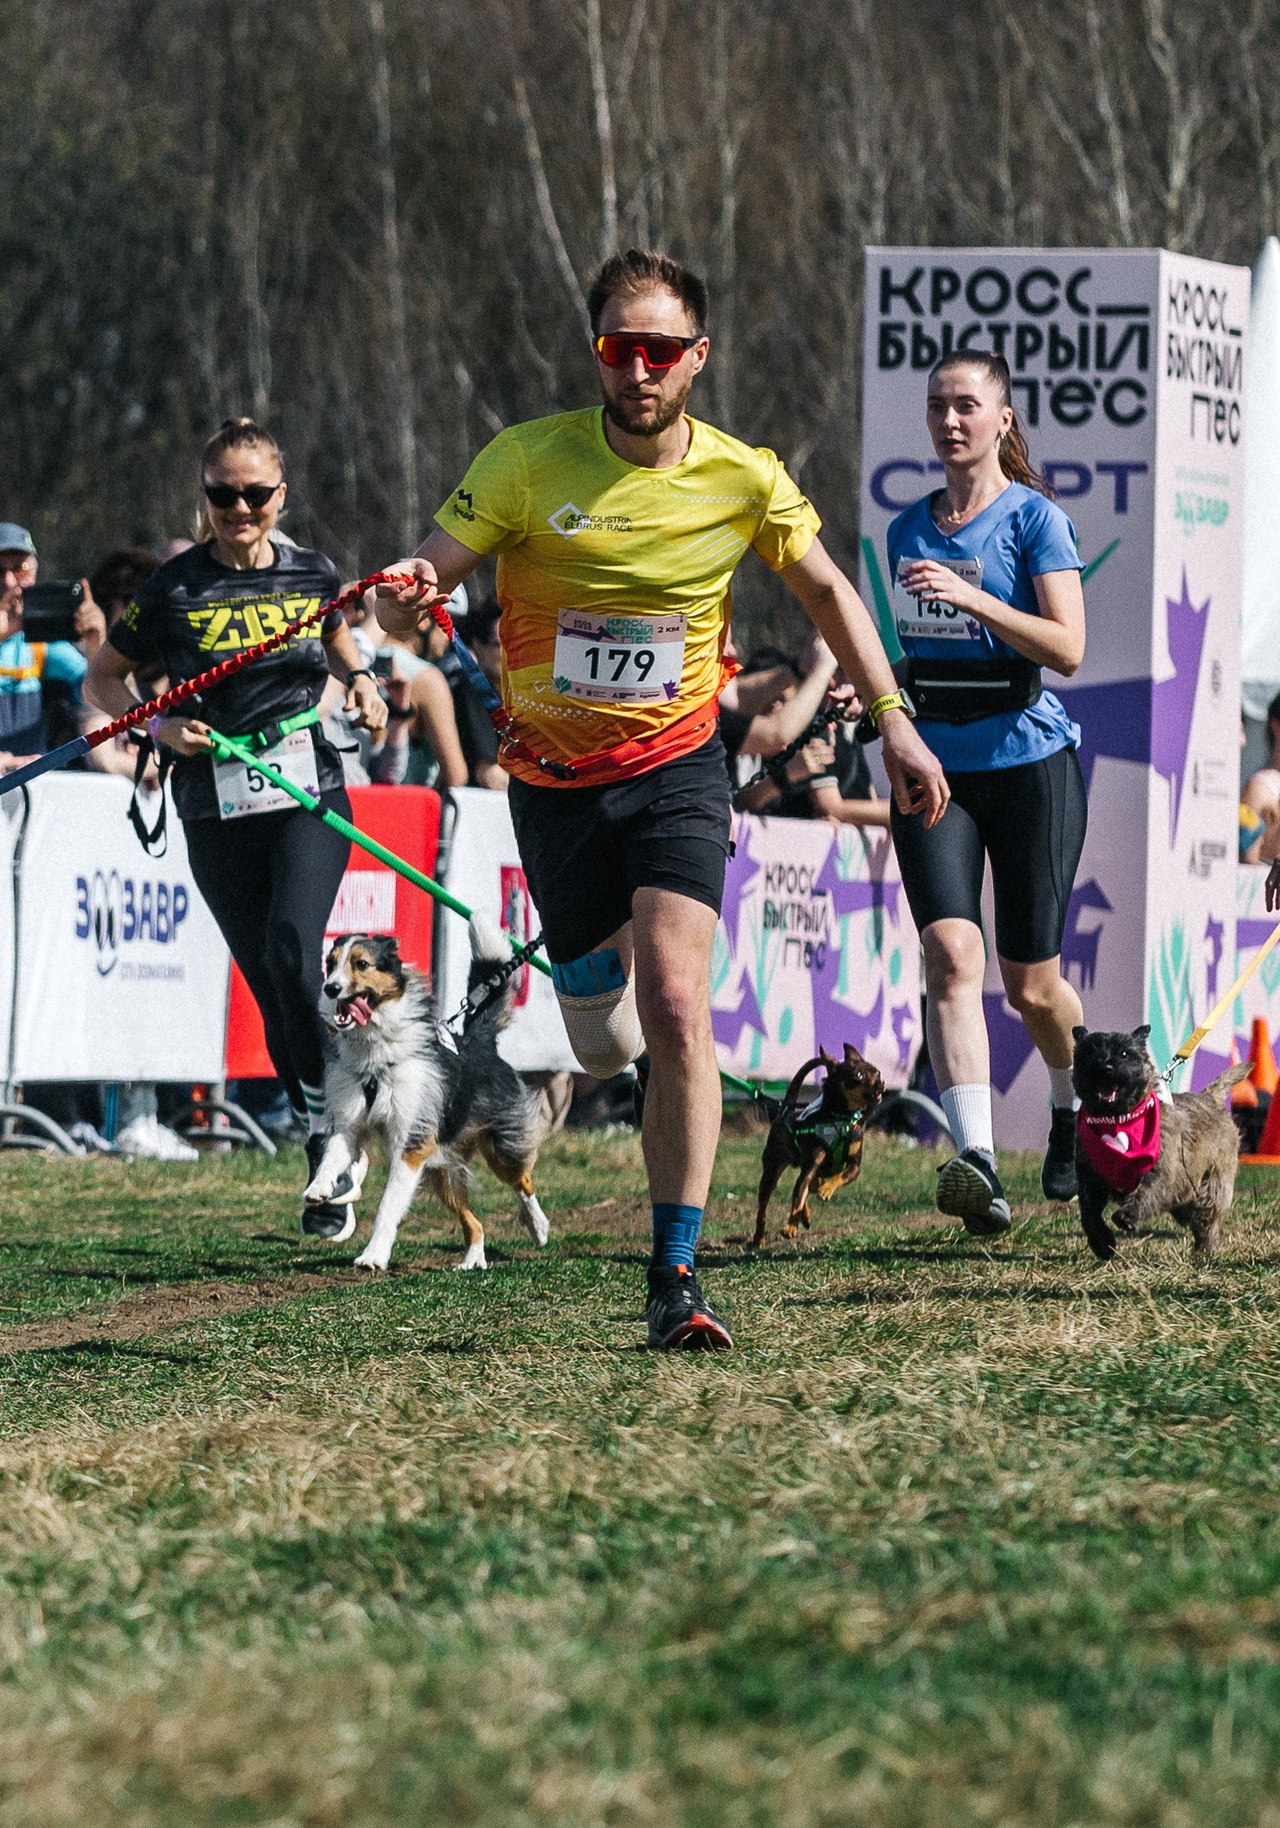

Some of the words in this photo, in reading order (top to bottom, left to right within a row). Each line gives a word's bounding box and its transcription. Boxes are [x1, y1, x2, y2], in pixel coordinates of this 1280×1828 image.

[870, 458, 1148, 515] СРТ
[564, 521, 603, 531] ELBRUS
[607, 523, 633, 532] RACE
[584, 646, 656, 683] 179
